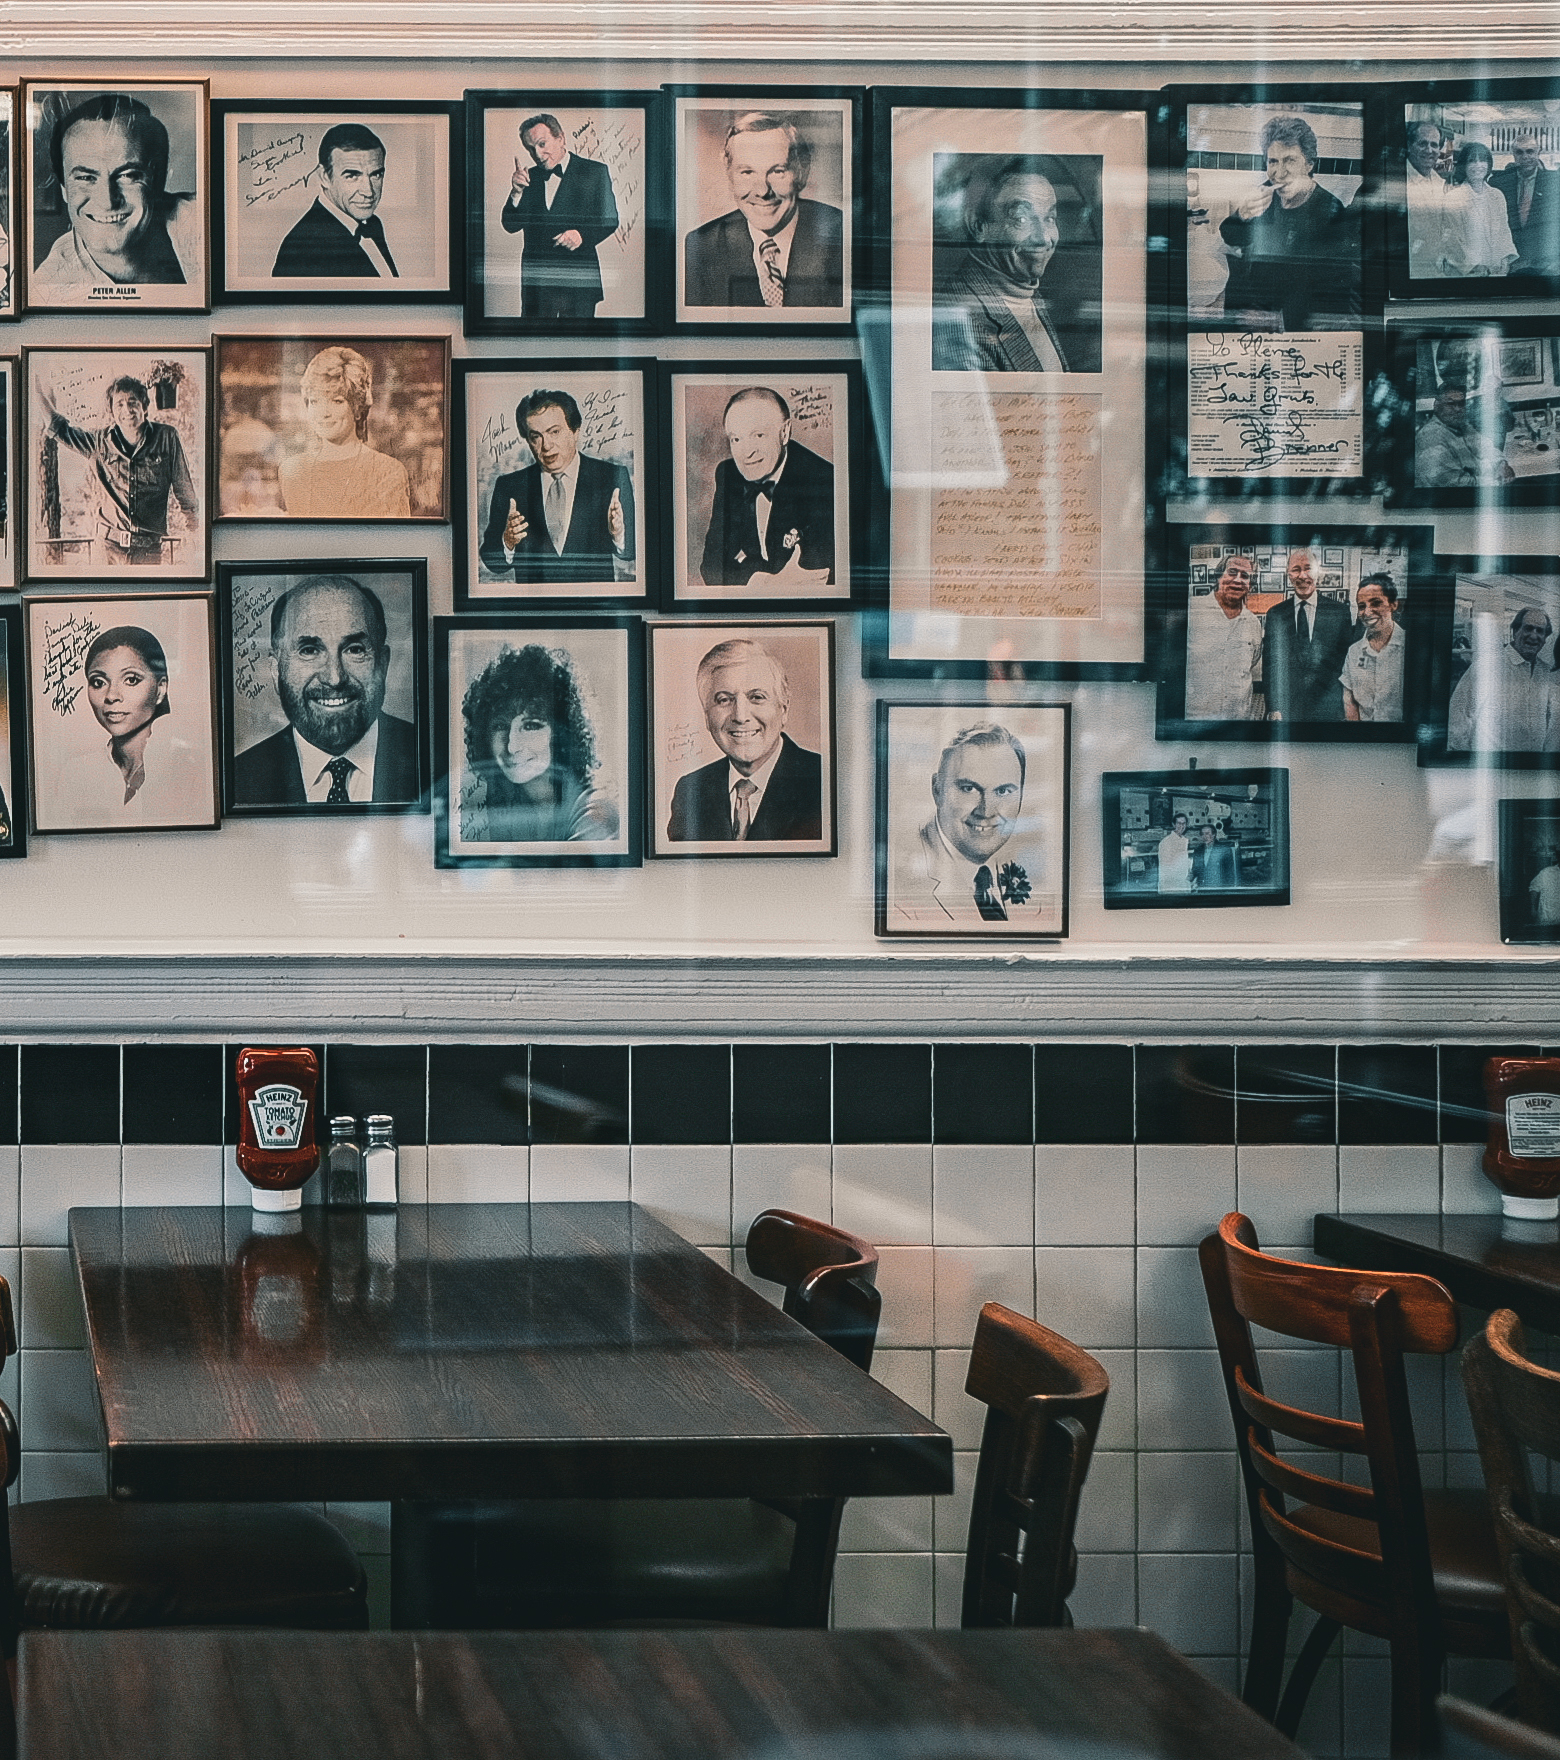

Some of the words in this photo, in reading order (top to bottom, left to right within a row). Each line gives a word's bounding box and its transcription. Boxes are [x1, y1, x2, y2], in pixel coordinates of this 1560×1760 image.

[92, 287, 114, 295] PETER
[115, 287, 137, 295] ALLEN
[1190, 361, 1281, 382] Thanks
[1290, 354, 1320, 386] for
[265, 1093, 293, 1102] HEINZ
[1524, 1098, 1553, 1108] HEINZ
[264, 1107, 295, 1115] TOMATO
